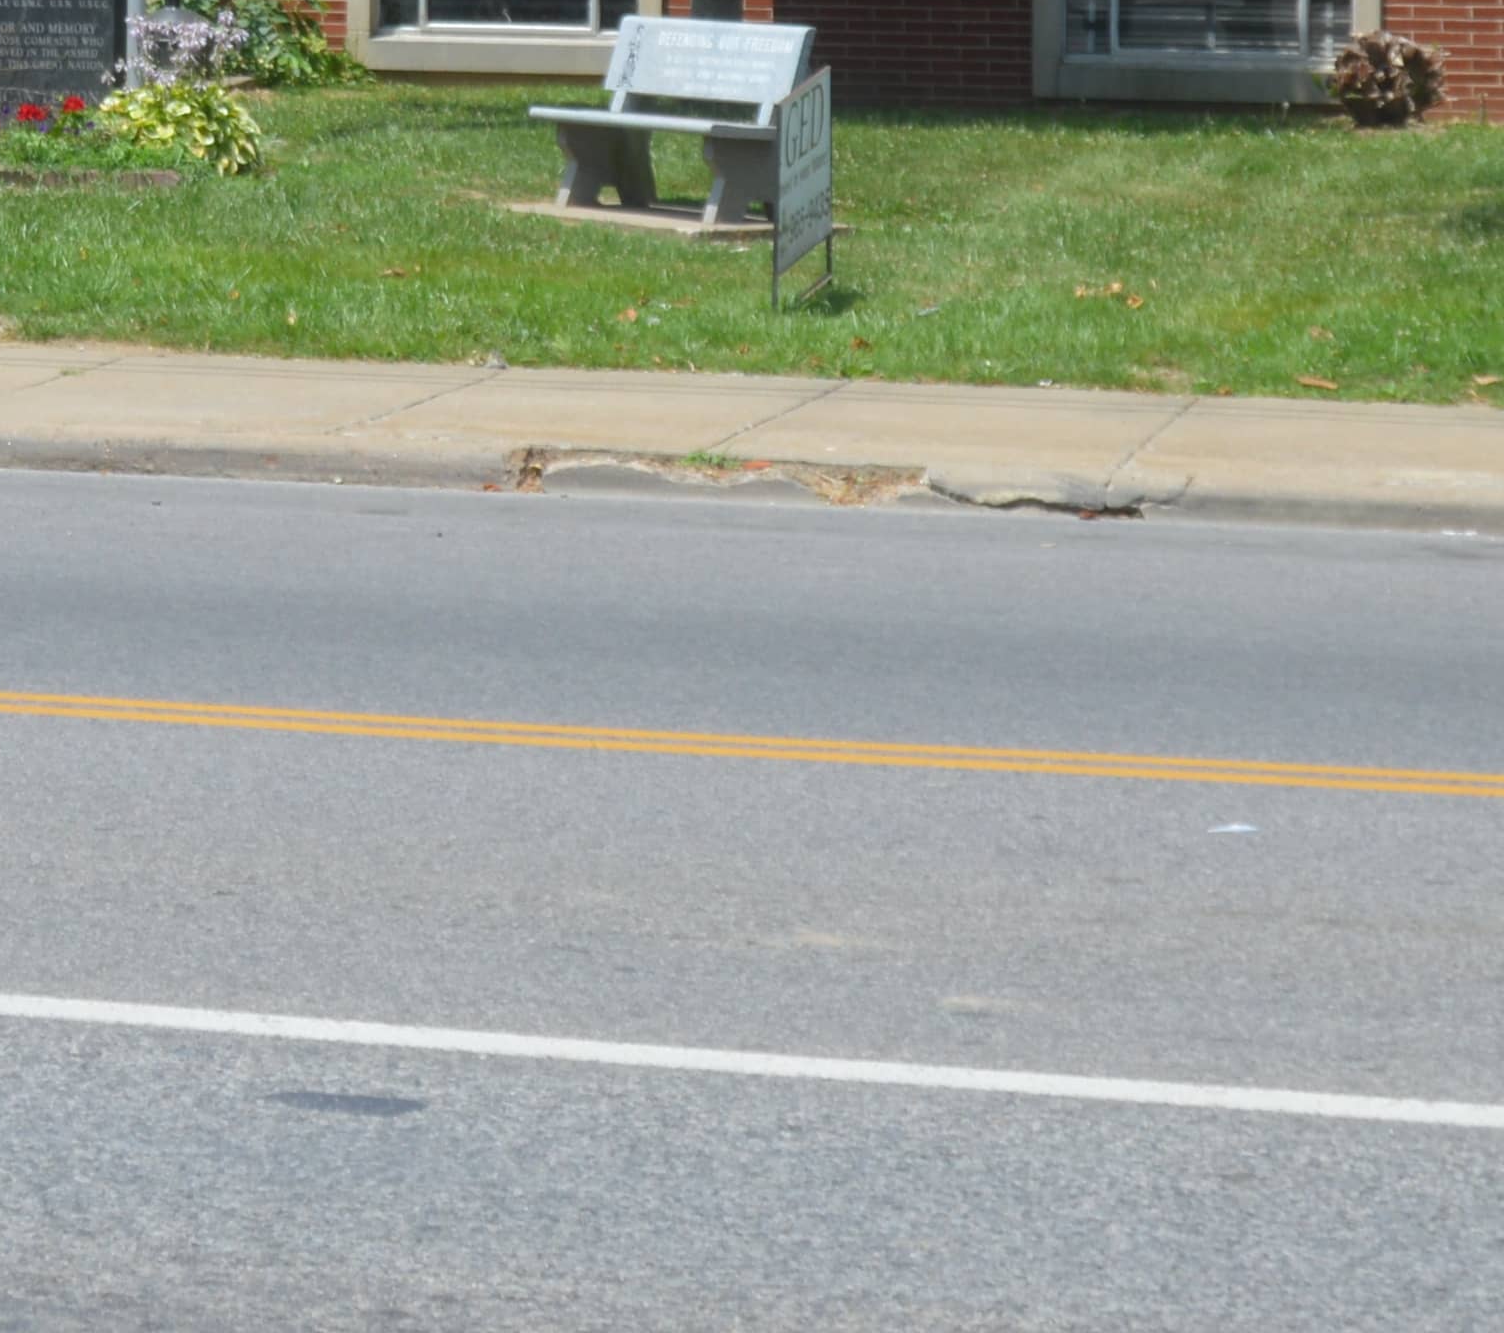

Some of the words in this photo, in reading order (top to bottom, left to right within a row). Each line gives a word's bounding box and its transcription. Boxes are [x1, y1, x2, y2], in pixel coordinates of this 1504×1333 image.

[21, 23, 45, 34] AND
[48, 22, 97, 35] MEMORY
[786, 84, 825, 168] GED
